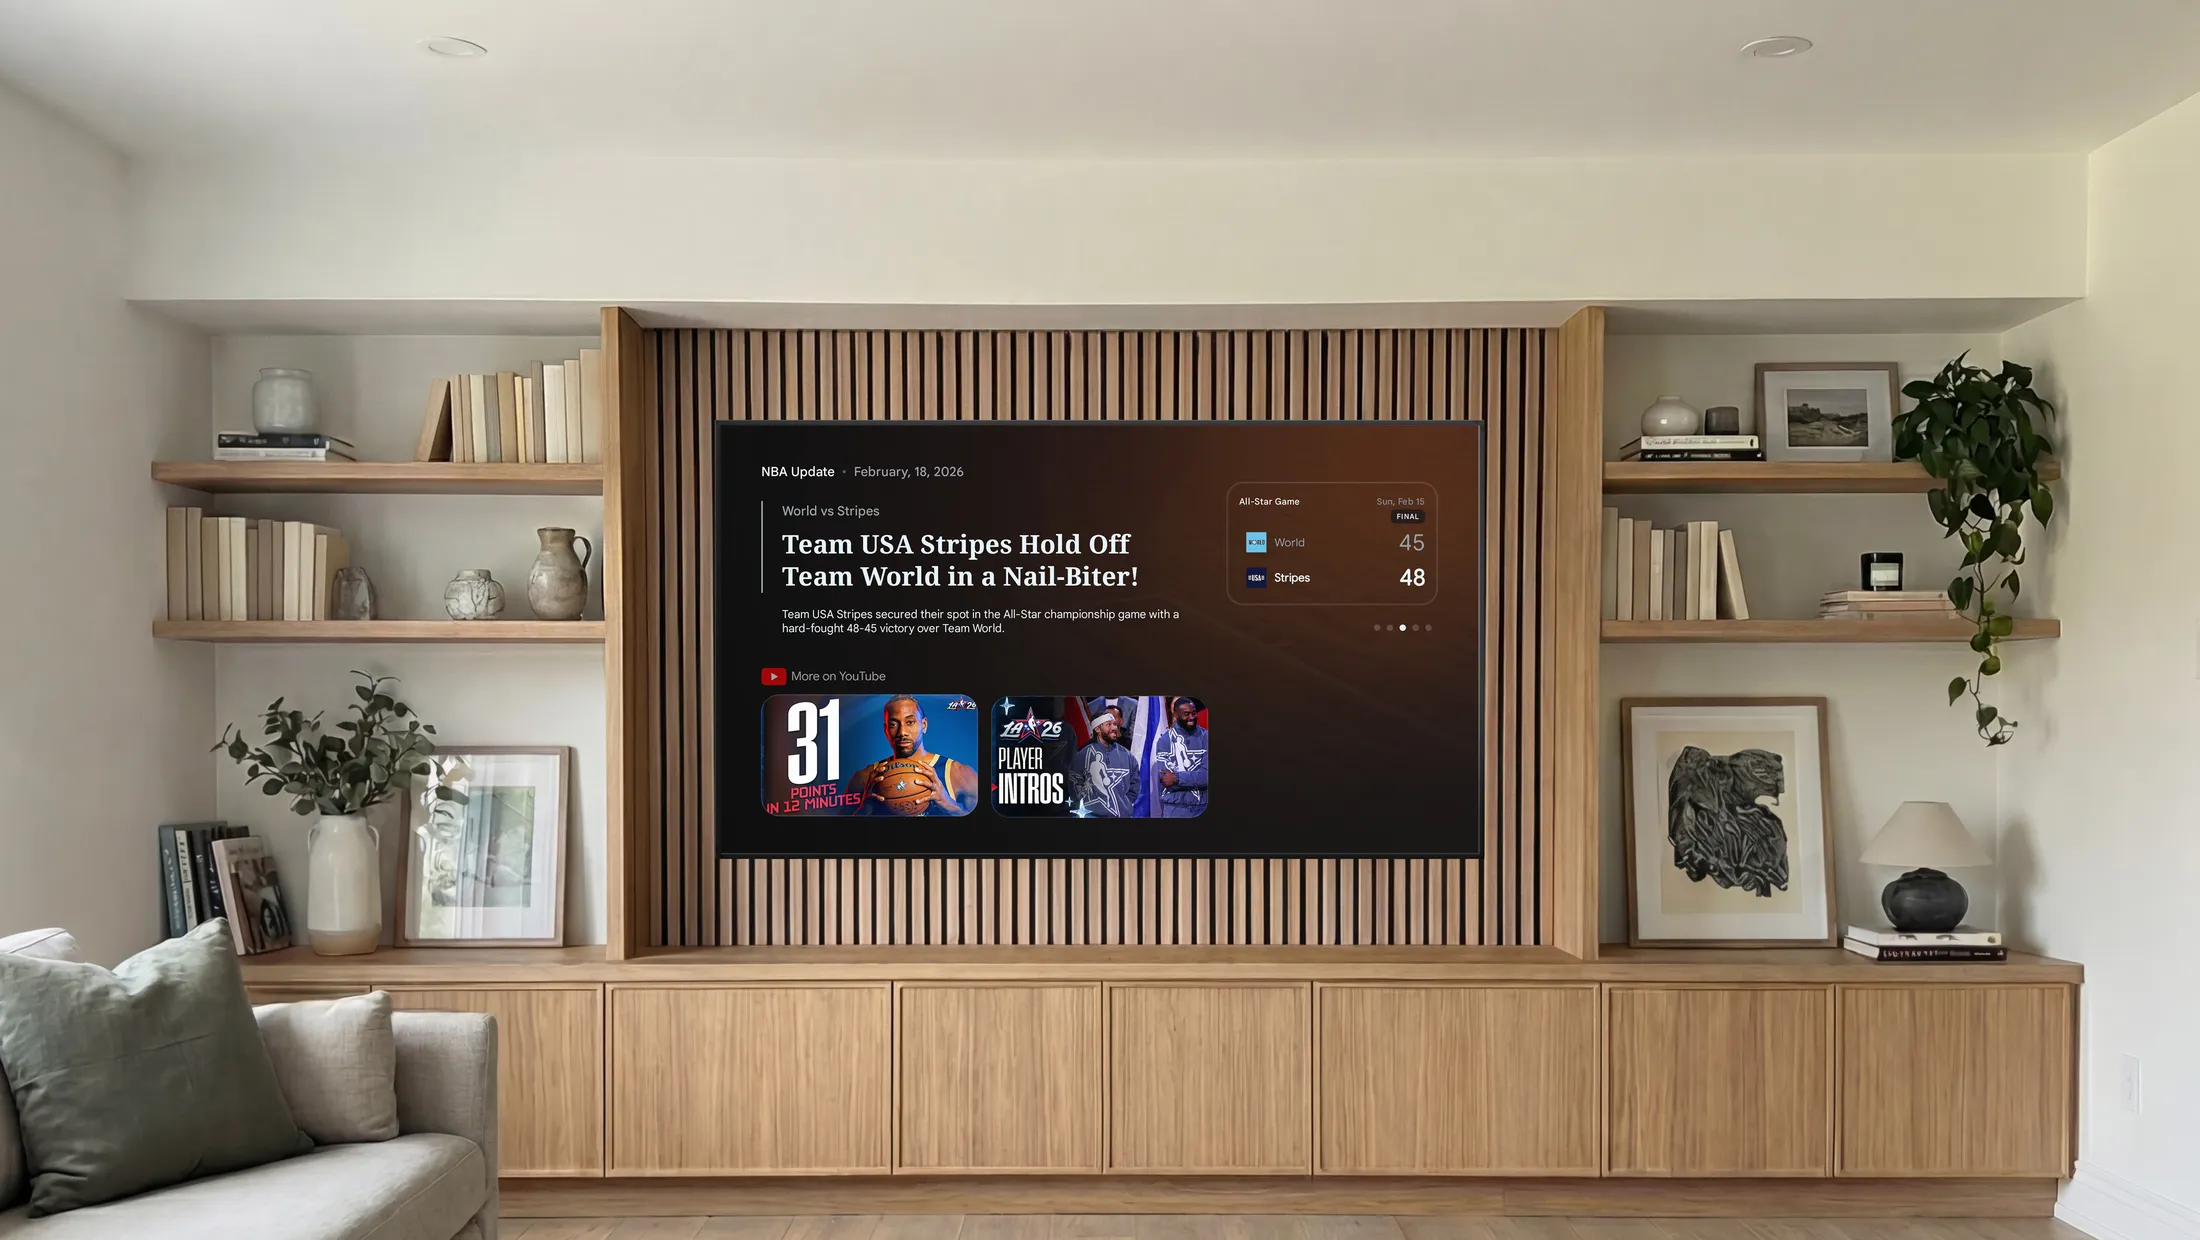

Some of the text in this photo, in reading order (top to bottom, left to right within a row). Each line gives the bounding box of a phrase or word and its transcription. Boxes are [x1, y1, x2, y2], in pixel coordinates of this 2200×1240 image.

[761, 466, 964, 480] NBA Update February, 18, 2026
[1239, 497, 1300, 506] All-Star Game
[1376, 497, 1425, 507] Sun, Feb 15
[782, 504, 880, 519] World vs Stripes
[782, 533, 1132, 561] Team USA Stripes Hold Off
[1274, 537, 1305, 548] World
[1399, 533, 1425, 552] 45
[782, 565, 1138, 587] Team World in a Nail-Biter!
[1274, 572, 1311, 585] Stripes
[1399, 567, 1426, 587] 48
[782, 608, 1180, 622] Team USA Stripes secured their spot in the All-Star championship game with a
[782, 622, 1005, 636] hard-fought 48-45 victory over Team World.
[791, 670, 887, 682] More on YouTube
[1000, 720, 1063, 739] LA 26
[787, 698, 840, 785] 31
[998, 746, 1043, 770] PLAYER
[790, 783, 837, 800] POINTS
[998, 772, 1064, 805] INTROS
[766, 793, 861, 814] IN 12 MINUTES
